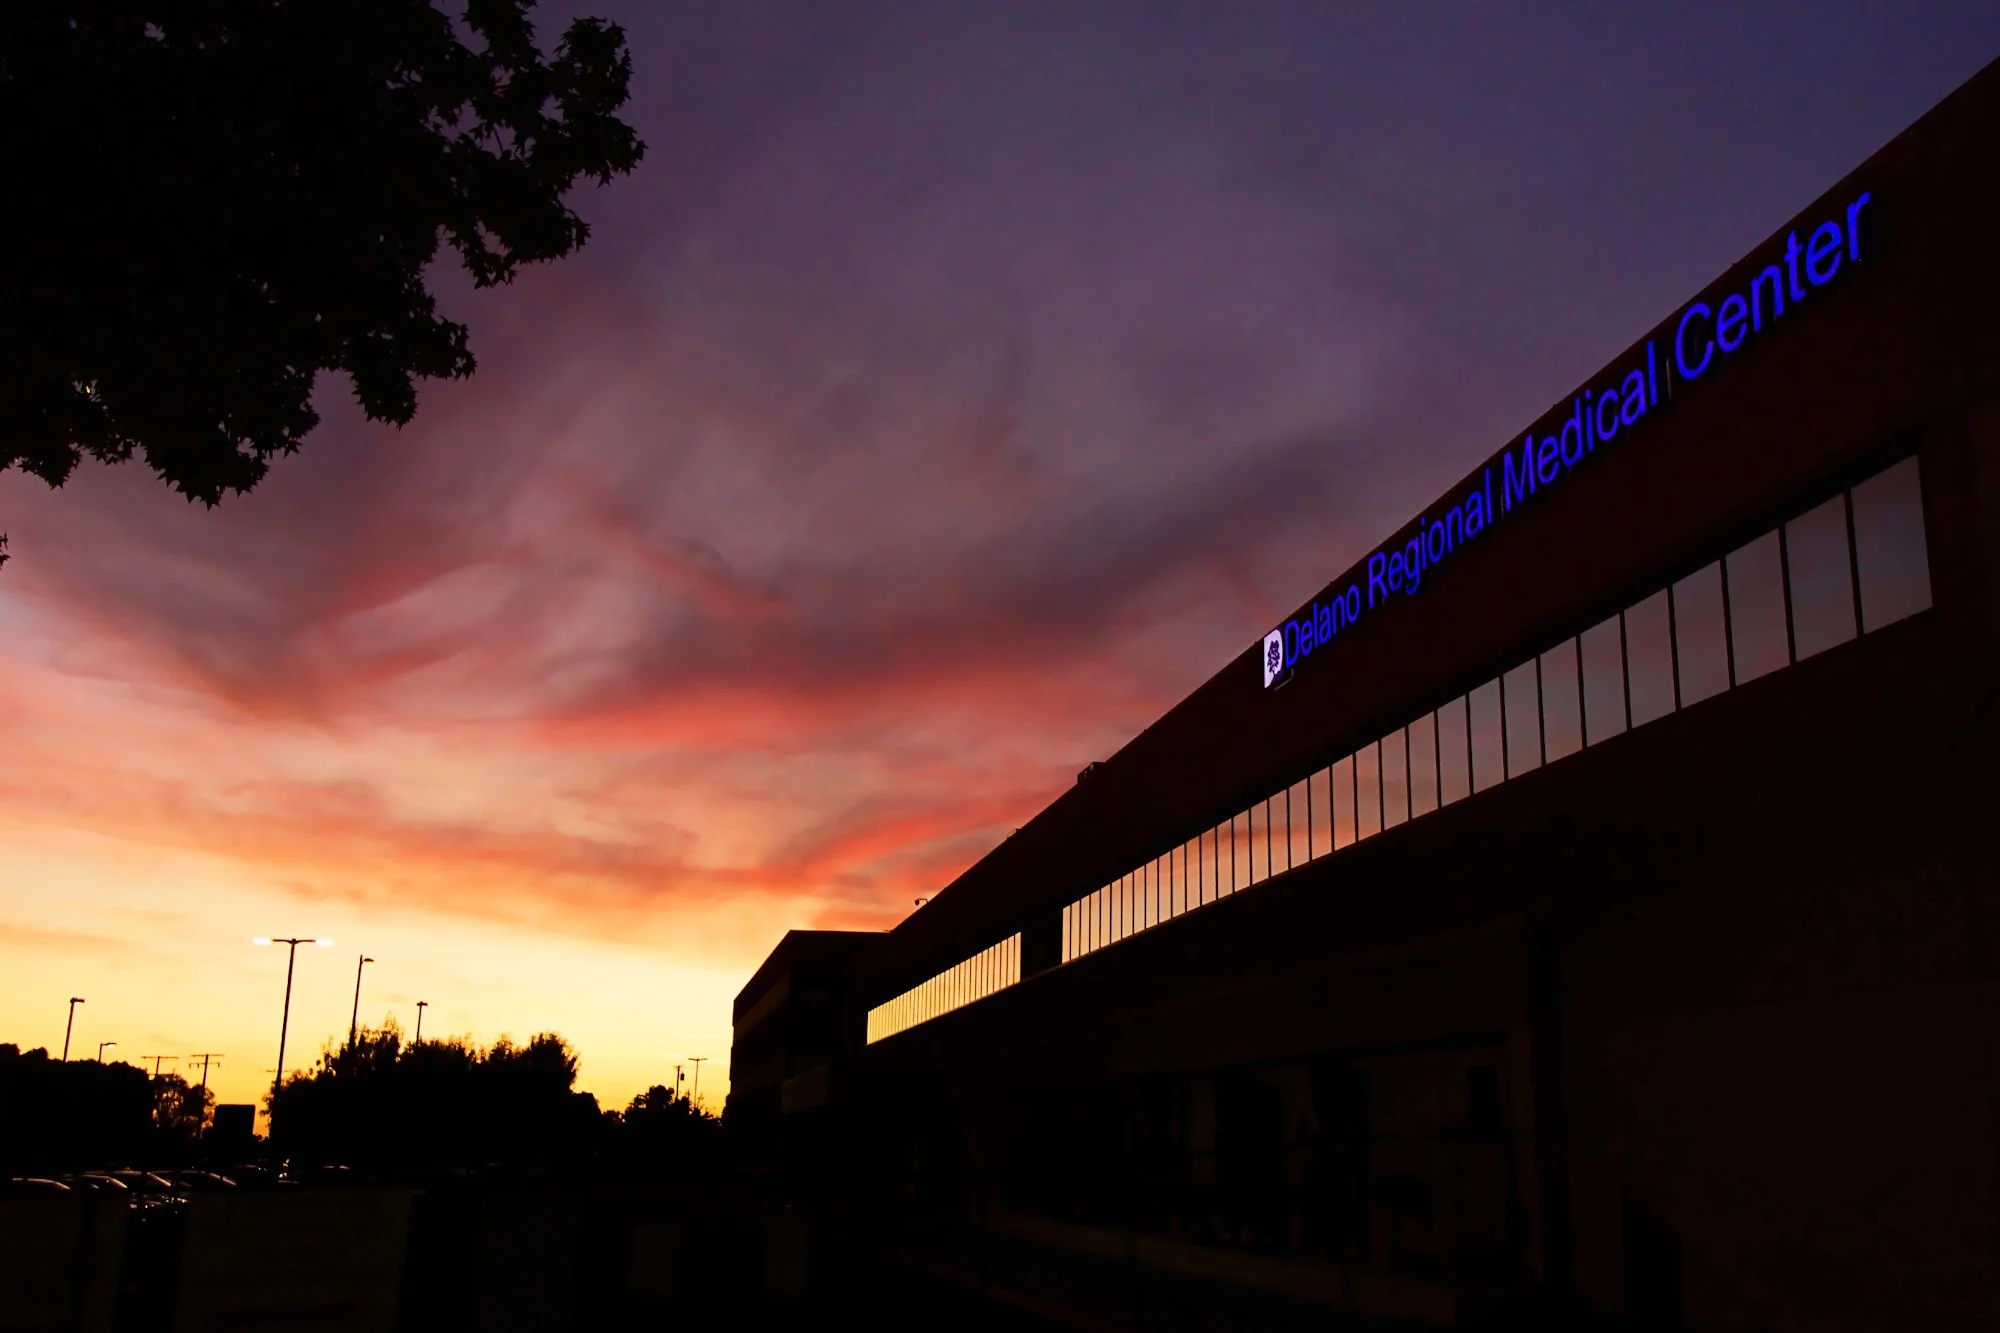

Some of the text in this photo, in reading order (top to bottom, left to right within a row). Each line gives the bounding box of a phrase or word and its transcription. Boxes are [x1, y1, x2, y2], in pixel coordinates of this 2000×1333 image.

[1284, 192, 1870, 668] Delano Regional Medical Center
